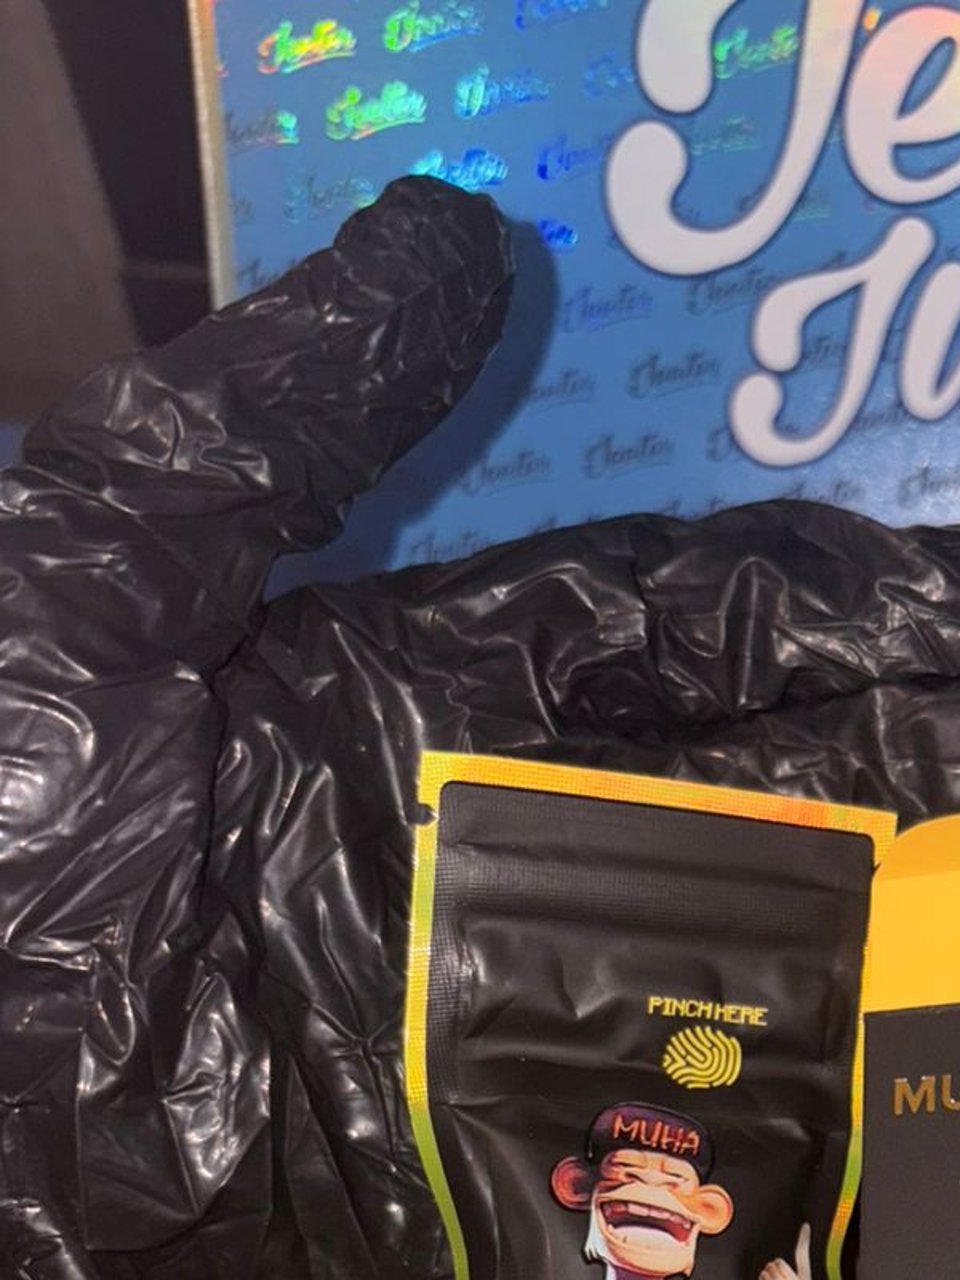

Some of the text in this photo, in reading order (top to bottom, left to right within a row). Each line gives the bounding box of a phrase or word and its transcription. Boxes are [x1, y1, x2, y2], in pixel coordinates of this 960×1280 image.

[648, 995, 769, 1027] PINCH HERE
[613, 1114, 701, 1156] MUHA
